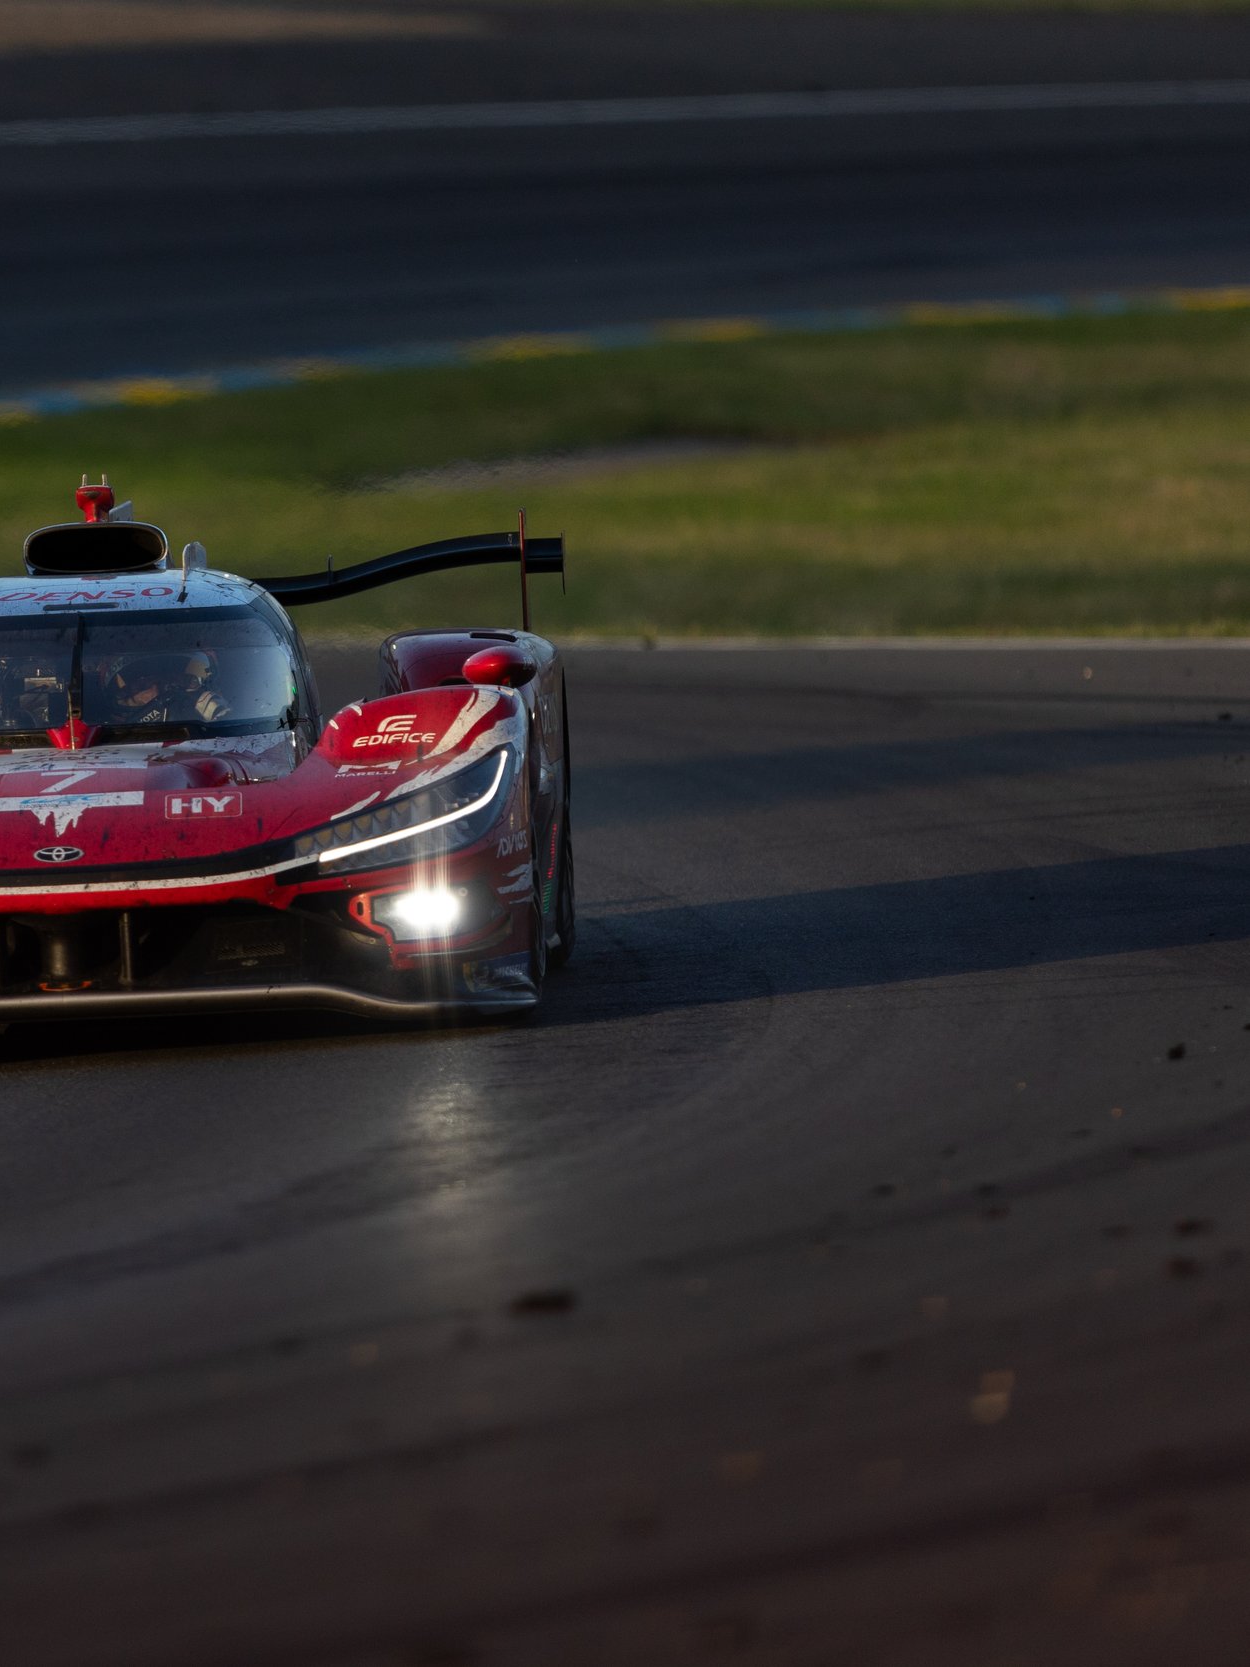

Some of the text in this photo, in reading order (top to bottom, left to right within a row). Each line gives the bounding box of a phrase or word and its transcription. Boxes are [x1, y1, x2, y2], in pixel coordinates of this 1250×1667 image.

[352, 732, 437, 748] EDIFICE
[39, 770, 97, 793] 7
[334, 770, 397, 778] MARELLI
[171, 796, 236, 814] HY
